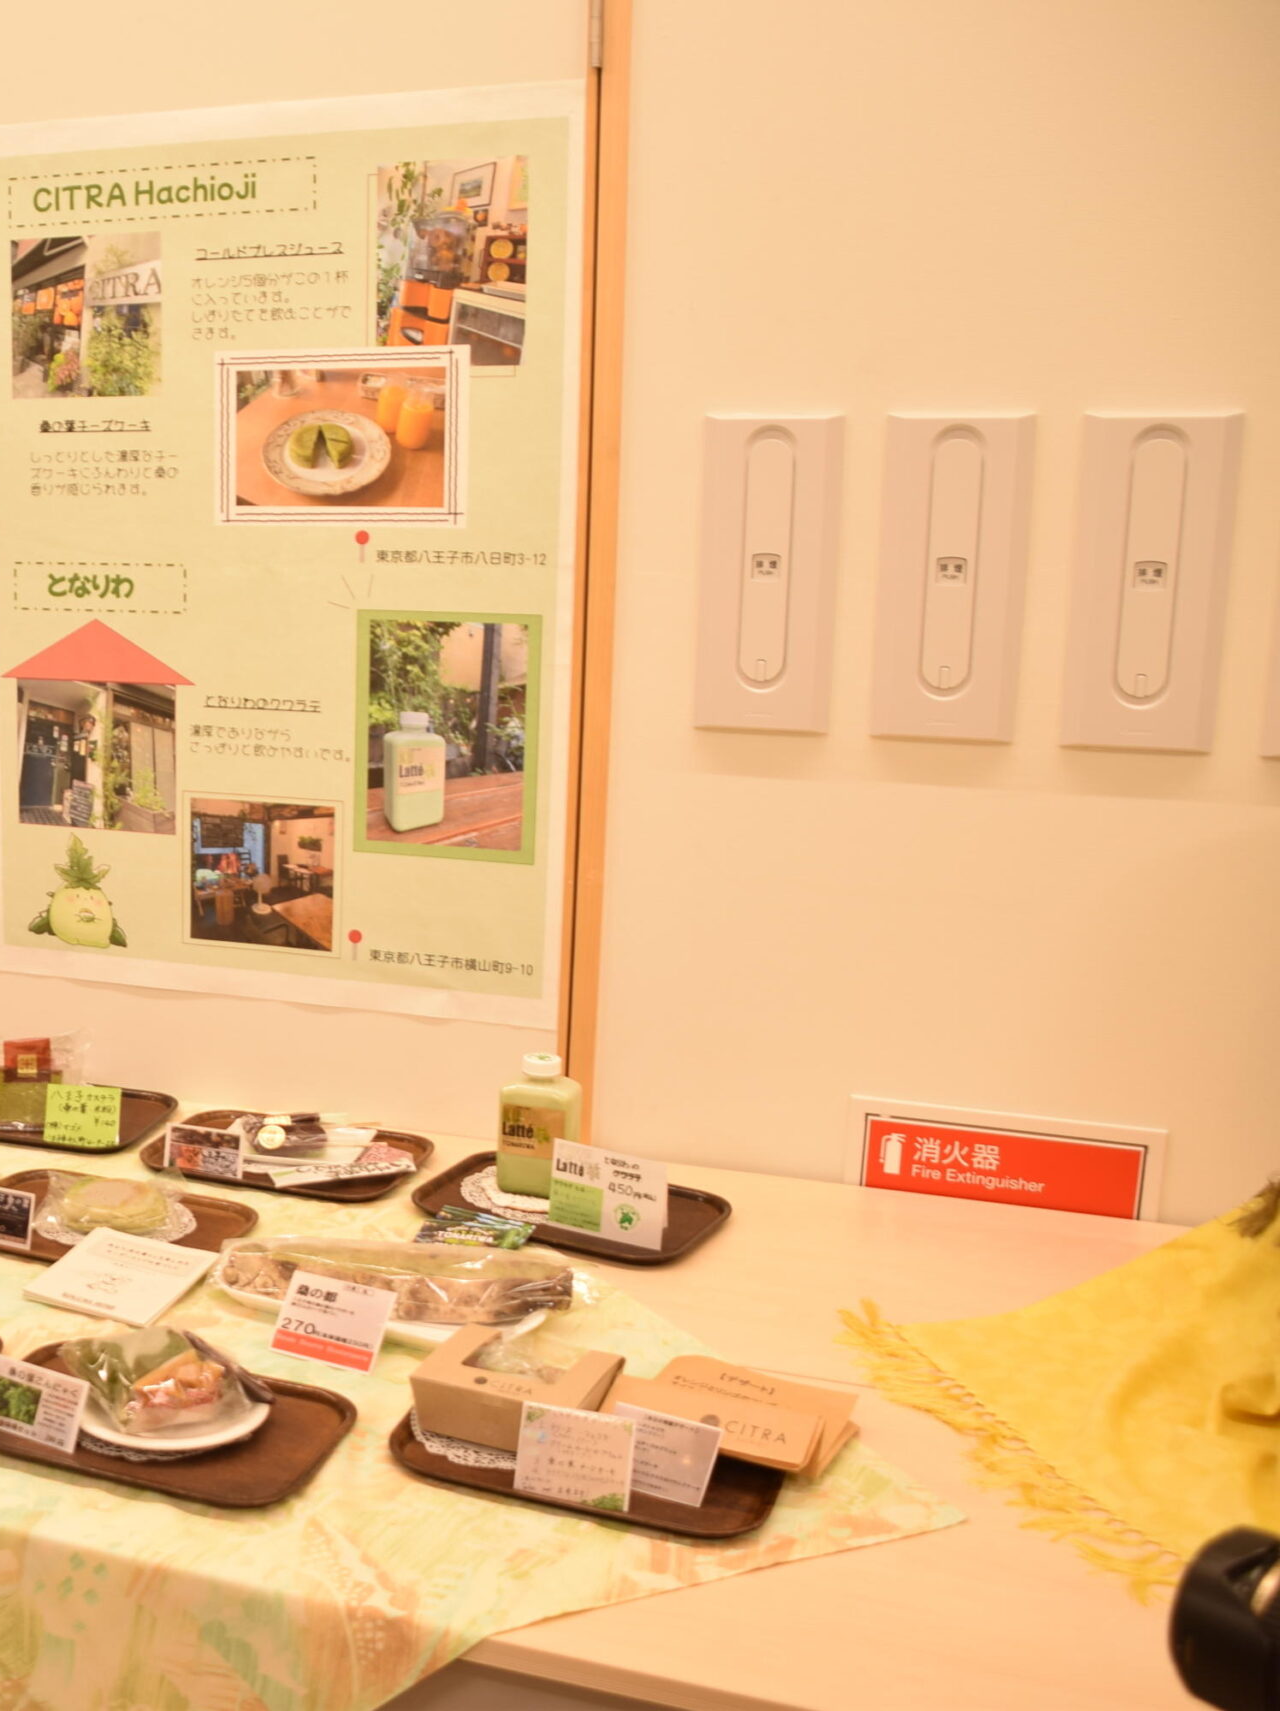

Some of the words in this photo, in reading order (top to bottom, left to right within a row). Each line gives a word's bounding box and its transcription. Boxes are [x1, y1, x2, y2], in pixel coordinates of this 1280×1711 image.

[33, 183, 126, 214] CITRA
[133, 173, 258, 208] Hachioji
[195, 241, 344, 260] コールドプレスジュース
[39, 419, 151, 433] 桑の葉チーズケーキ
[376, 549, 547, 566] 東京都八王子市八日町3-12
[47, 573, 136, 601] となりわ
[204, 695, 322, 713] となりわのクワラテ
[370, 948, 534, 976] 東京都八王子市横山町9-10
[911, 1135, 1001, 1172] 消火器
[911, 1163, 942, 1183] Fire
[945, 1169, 1046, 1195] Extinguisher
[296, 1284, 339, 1303] 桑の都
[724, 1419, 787, 1446] CITRA
